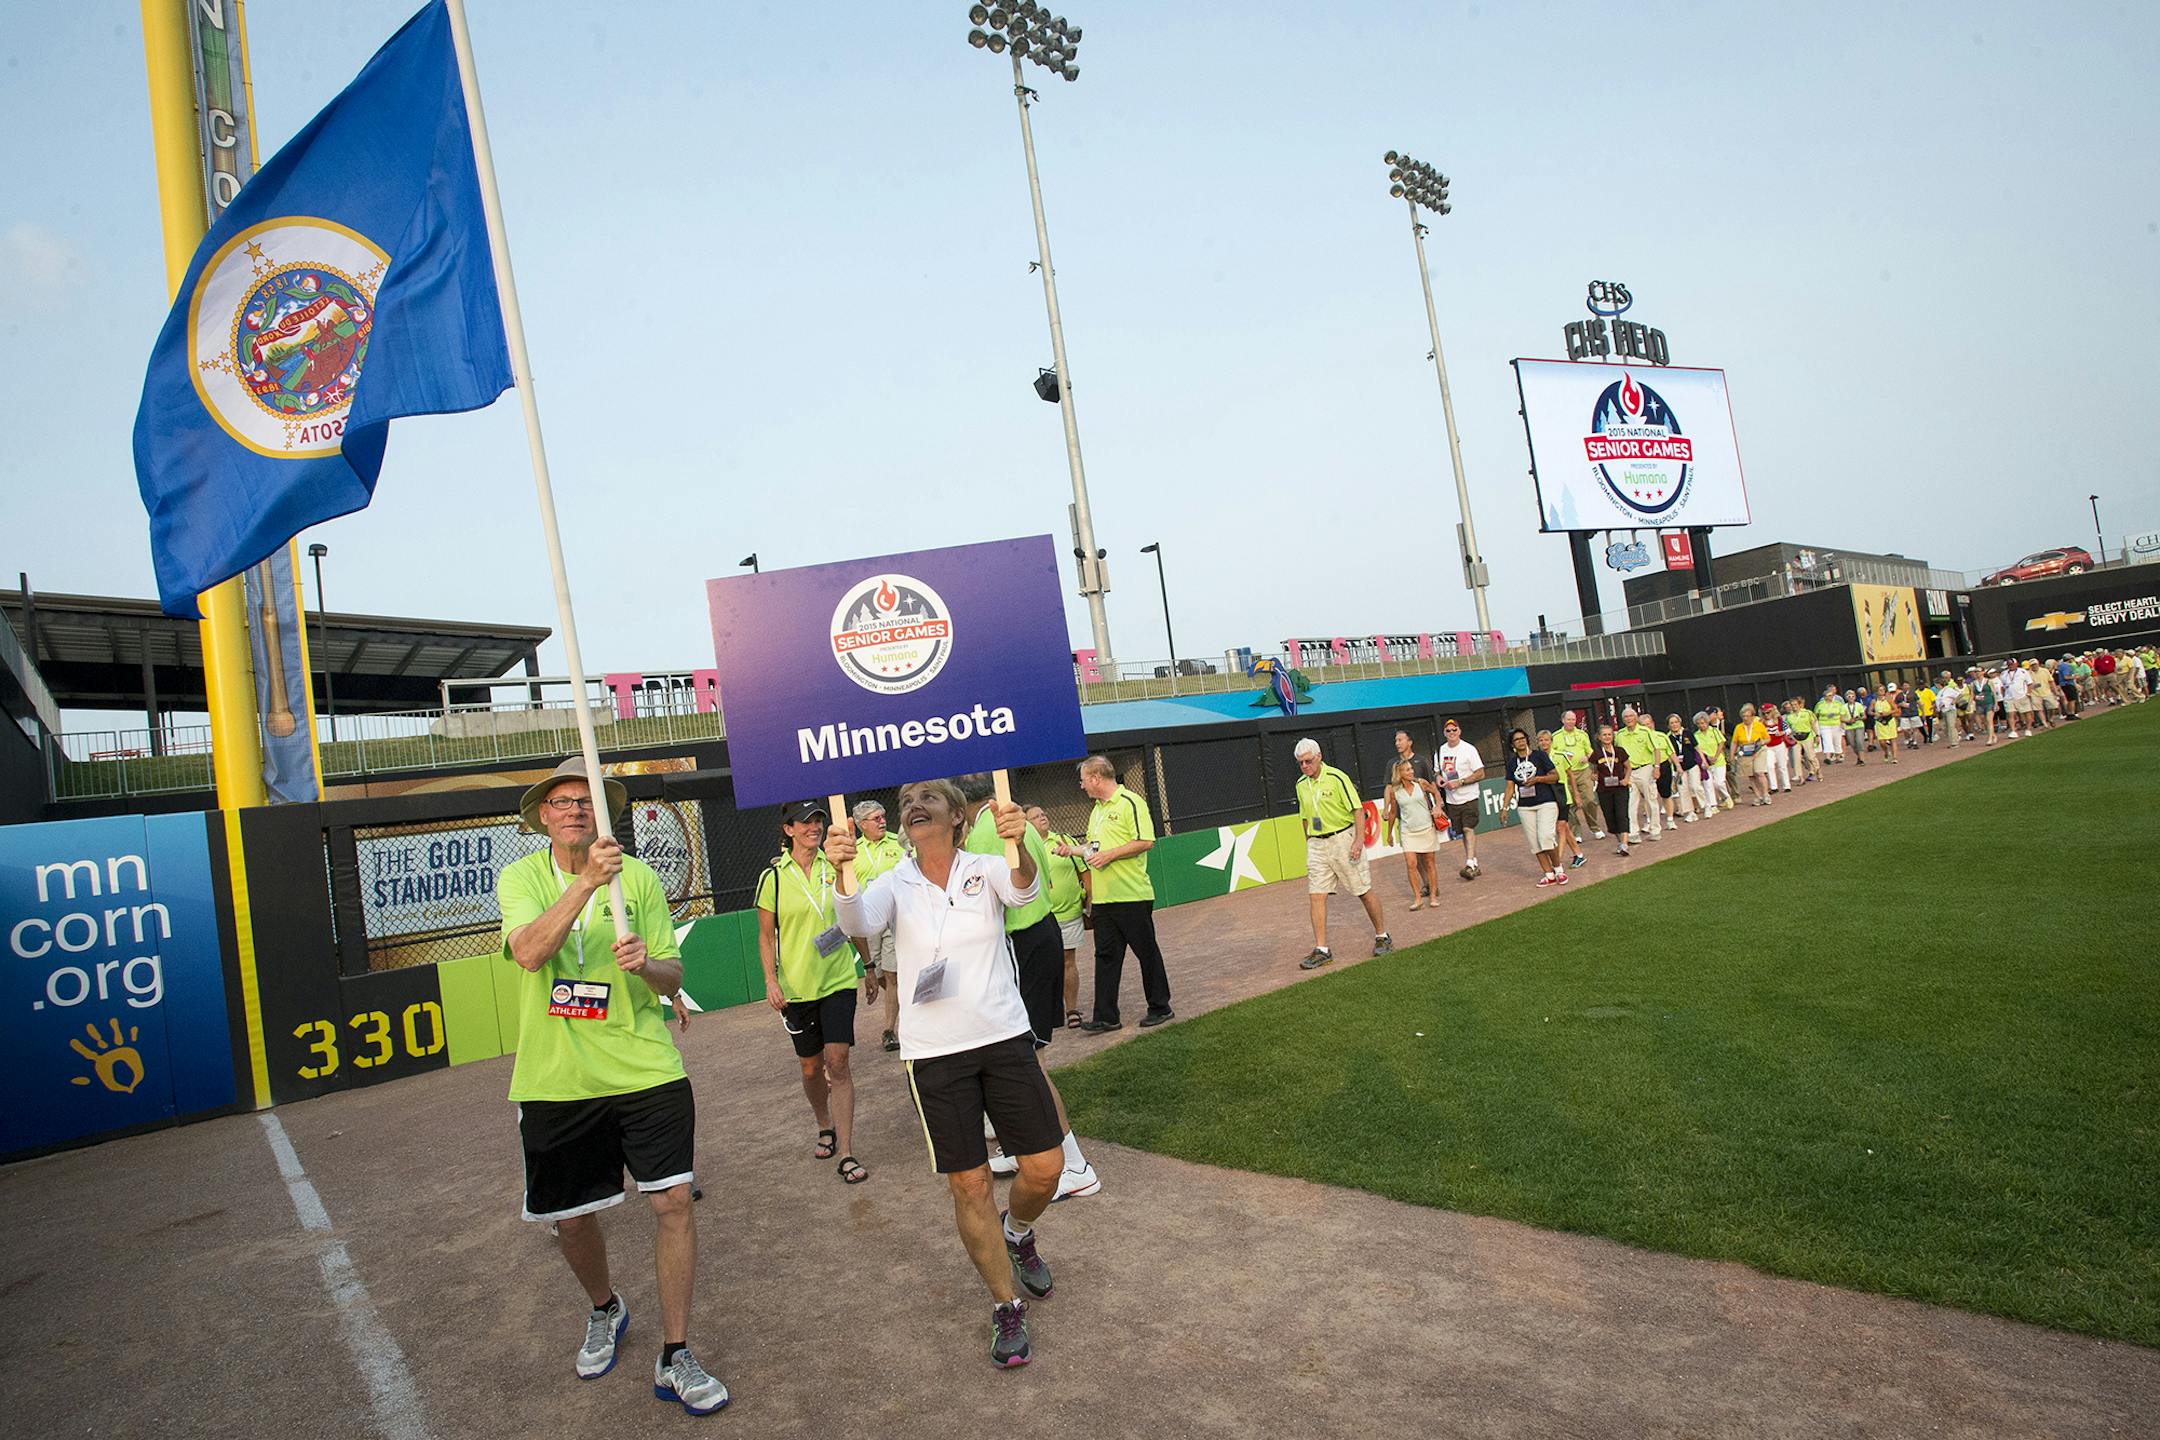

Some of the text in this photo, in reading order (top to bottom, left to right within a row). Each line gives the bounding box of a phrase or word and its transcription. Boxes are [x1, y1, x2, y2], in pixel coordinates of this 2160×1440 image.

[1588, 280, 1629, 304] CHS
[1563, 319, 1670, 366] CHS FIELD
[1607, 428, 1667, 438] 2015 NATIONAL
[1587, 441, 1690, 459] SENIOR GAMES
[1624, 471, 1668, 484] Humana
[1592, 466, 1633, 519] BLOOMINGTON
[1638, 510, 1679, 526] MINNEAPOLIS
[1926, 590, 1950, 615] RYAN
[2088, 601, 2123, 614] SELECT
[859, 616, 921, 632] 2015 NATIONAL
[2089, 607, 2160, 627] CHEVY DEAL
[837, 624, 945, 649] SENIOR GAMES
[872, 649, 918, 664] Humana
[840, 655, 878, 689] BLOOMINGTON
[883, 676, 928, 692] MINNEAPOLIS
[929, 656, 943, 674] SAINT
[797, 703, 1016, 764] Minnesota
[373, 837, 493, 877] THE GOLD
[35, 854, 148, 902] mn
[373, 867, 494, 908] STANDARD
[10, 902, 172, 959] corn
[33, 955, 165, 1011] .org
[549, 1006, 588, 1017] ATHLETE
[293, 1001, 445, 1080] 330
